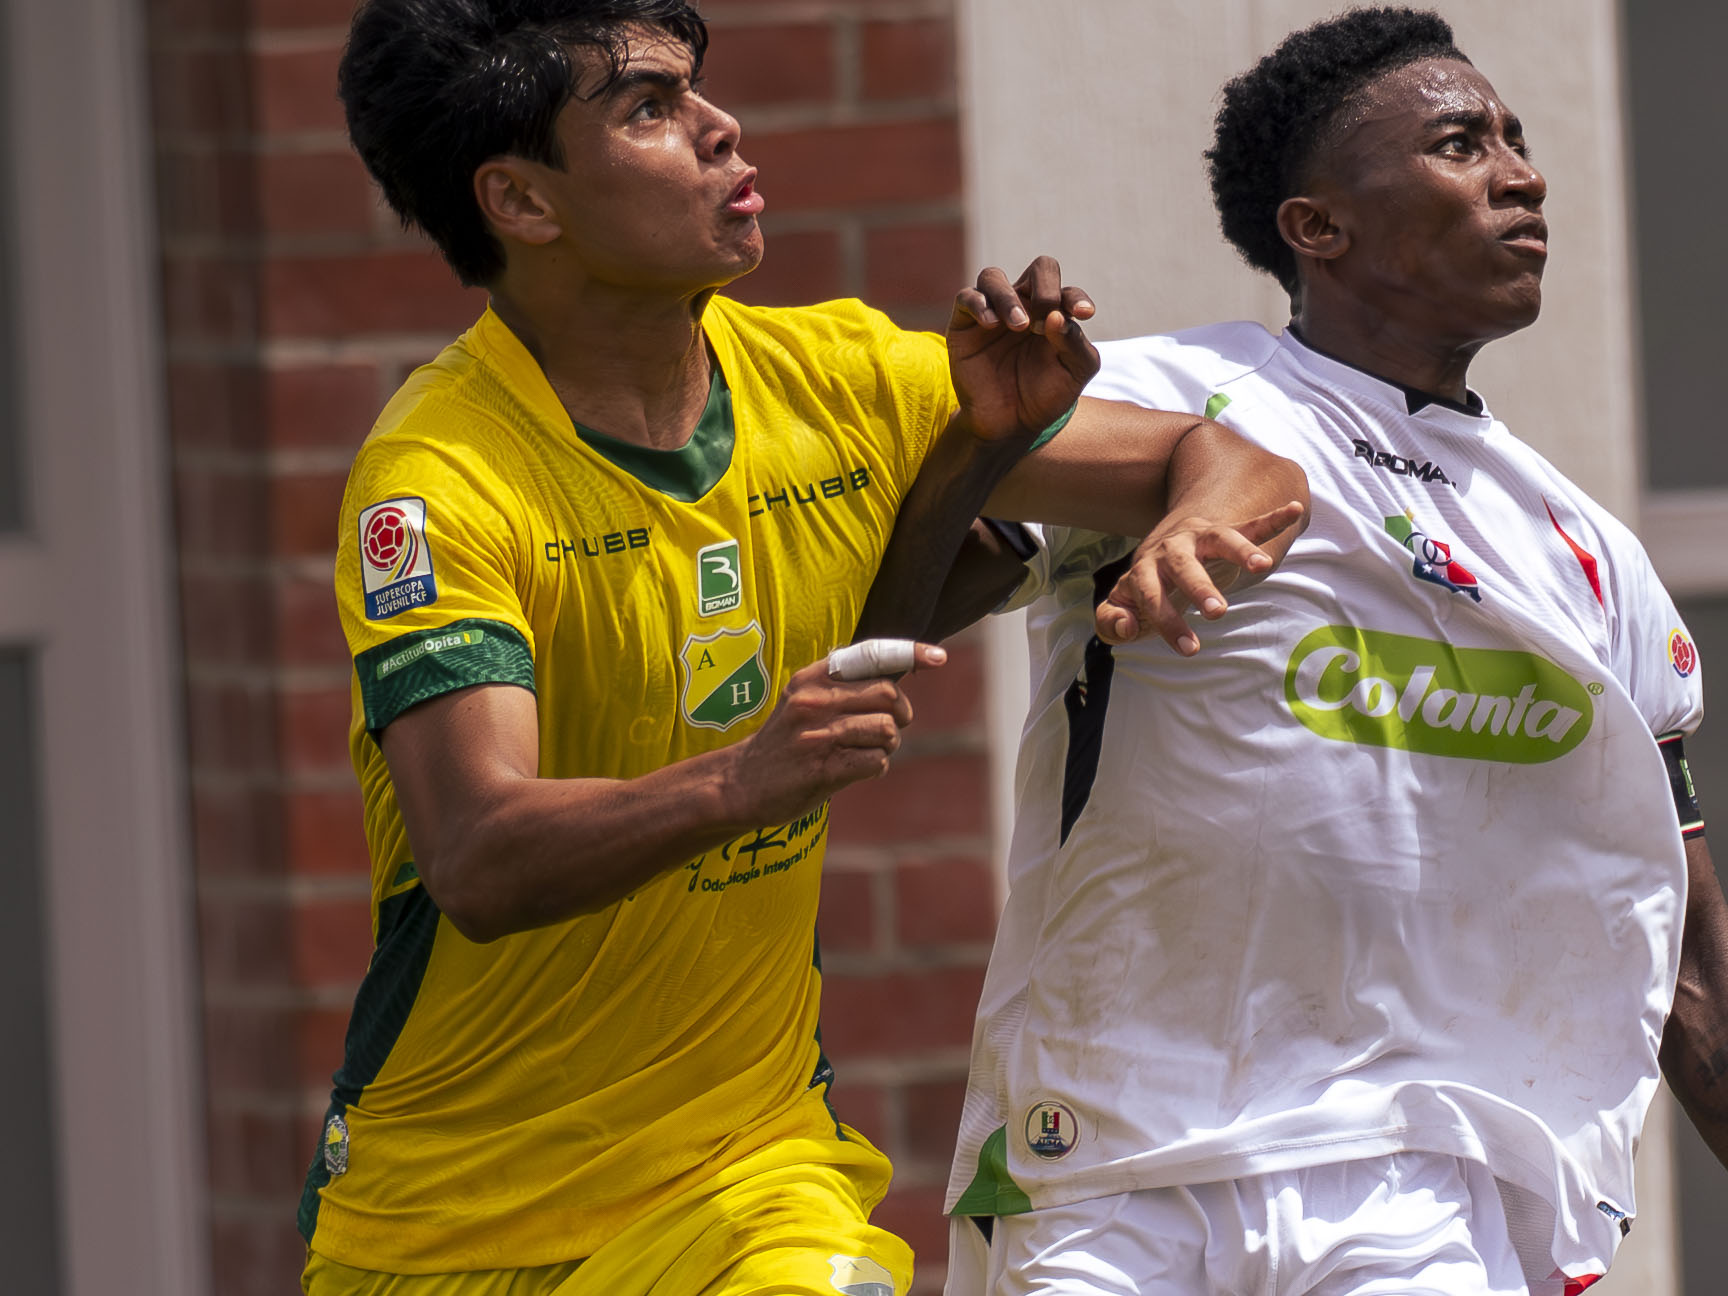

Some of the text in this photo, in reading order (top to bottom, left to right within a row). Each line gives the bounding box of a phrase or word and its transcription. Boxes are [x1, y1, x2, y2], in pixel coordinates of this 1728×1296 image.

[375, 580, 425, 605] SUPERCOPA
[376, 590, 427, 616] JUVENIL FCF
[705, 595, 736, 612] BOMAN
[381, 634, 462, 674] #ActitudOpita
[697, 648, 715, 671] A
[730, 680, 753, 706] H
[1294, 646, 1584, 743] Colanta
